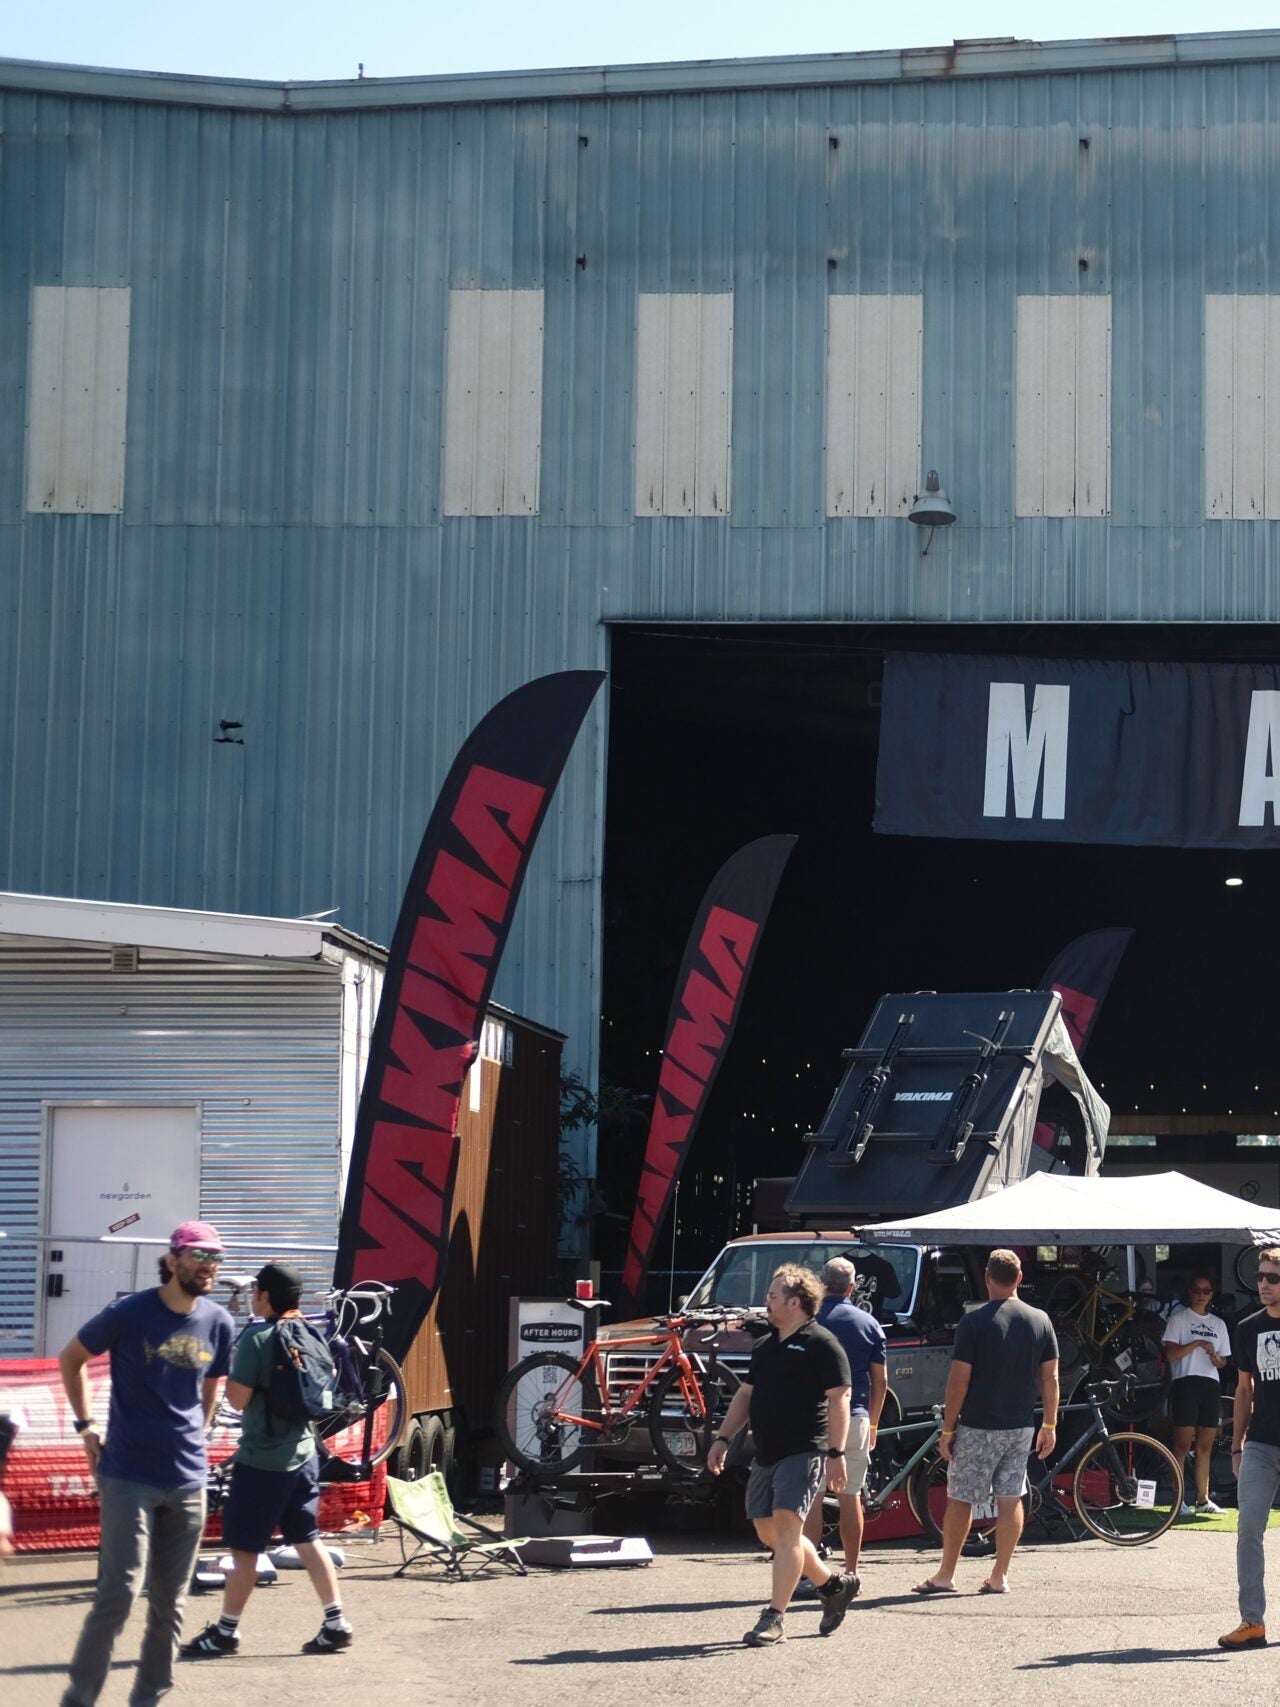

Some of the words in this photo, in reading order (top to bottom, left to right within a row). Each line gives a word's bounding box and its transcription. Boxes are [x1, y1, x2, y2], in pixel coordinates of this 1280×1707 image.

[351, 764, 546, 1291] YAKIMA
[621, 905, 758, 1296] YAKIMA
[893, 1092, 953, 1101] YAKIMA
[99, 1192, 152, 1200] nexgarden
[523, 1329, 549, 1337] AFTER
[551, 1329, 579, 1337] HOURS
